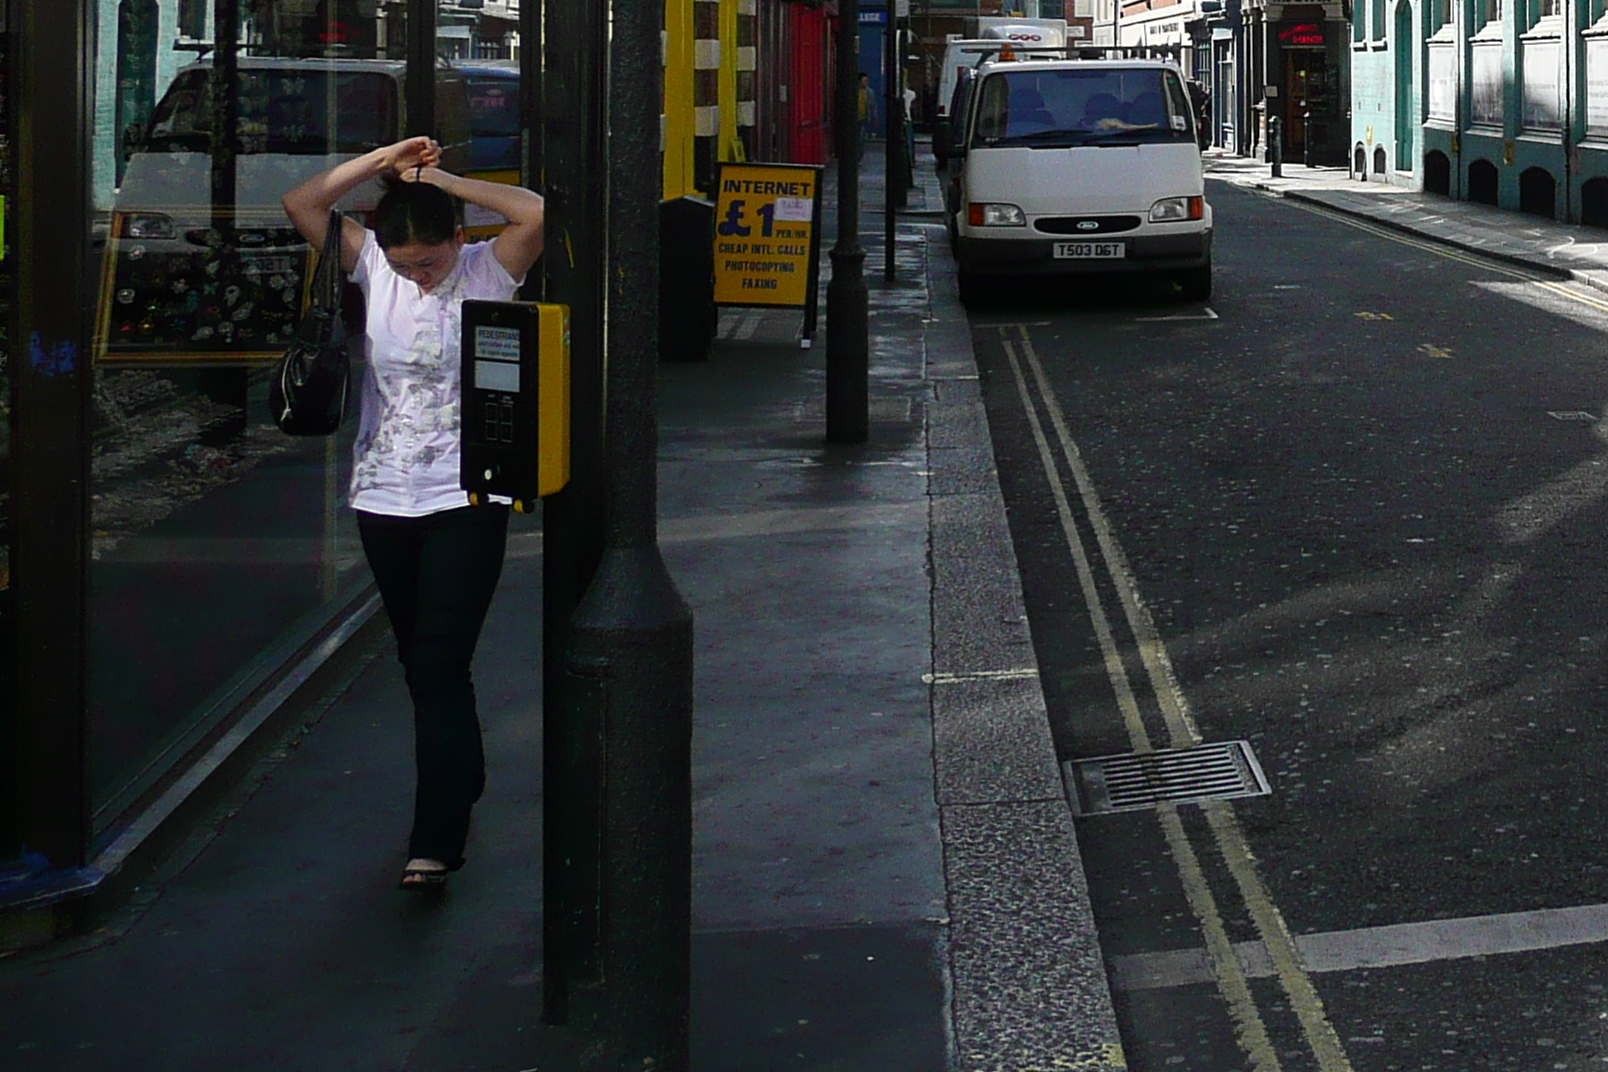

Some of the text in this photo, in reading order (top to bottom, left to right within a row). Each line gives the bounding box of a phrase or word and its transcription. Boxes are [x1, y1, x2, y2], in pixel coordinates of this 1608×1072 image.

[723, 180, 811, 196] INTERNET
[718, 199, 775, 238] £1
[718, 243, 748, 254] CHEAP
[778, 245, 805, 256] CALLS
[1058, 244, 1092, 257] T503
[725, 260, 795, 273] PHOTOCOPYING
[742, 278, 777, 289] FAXING
